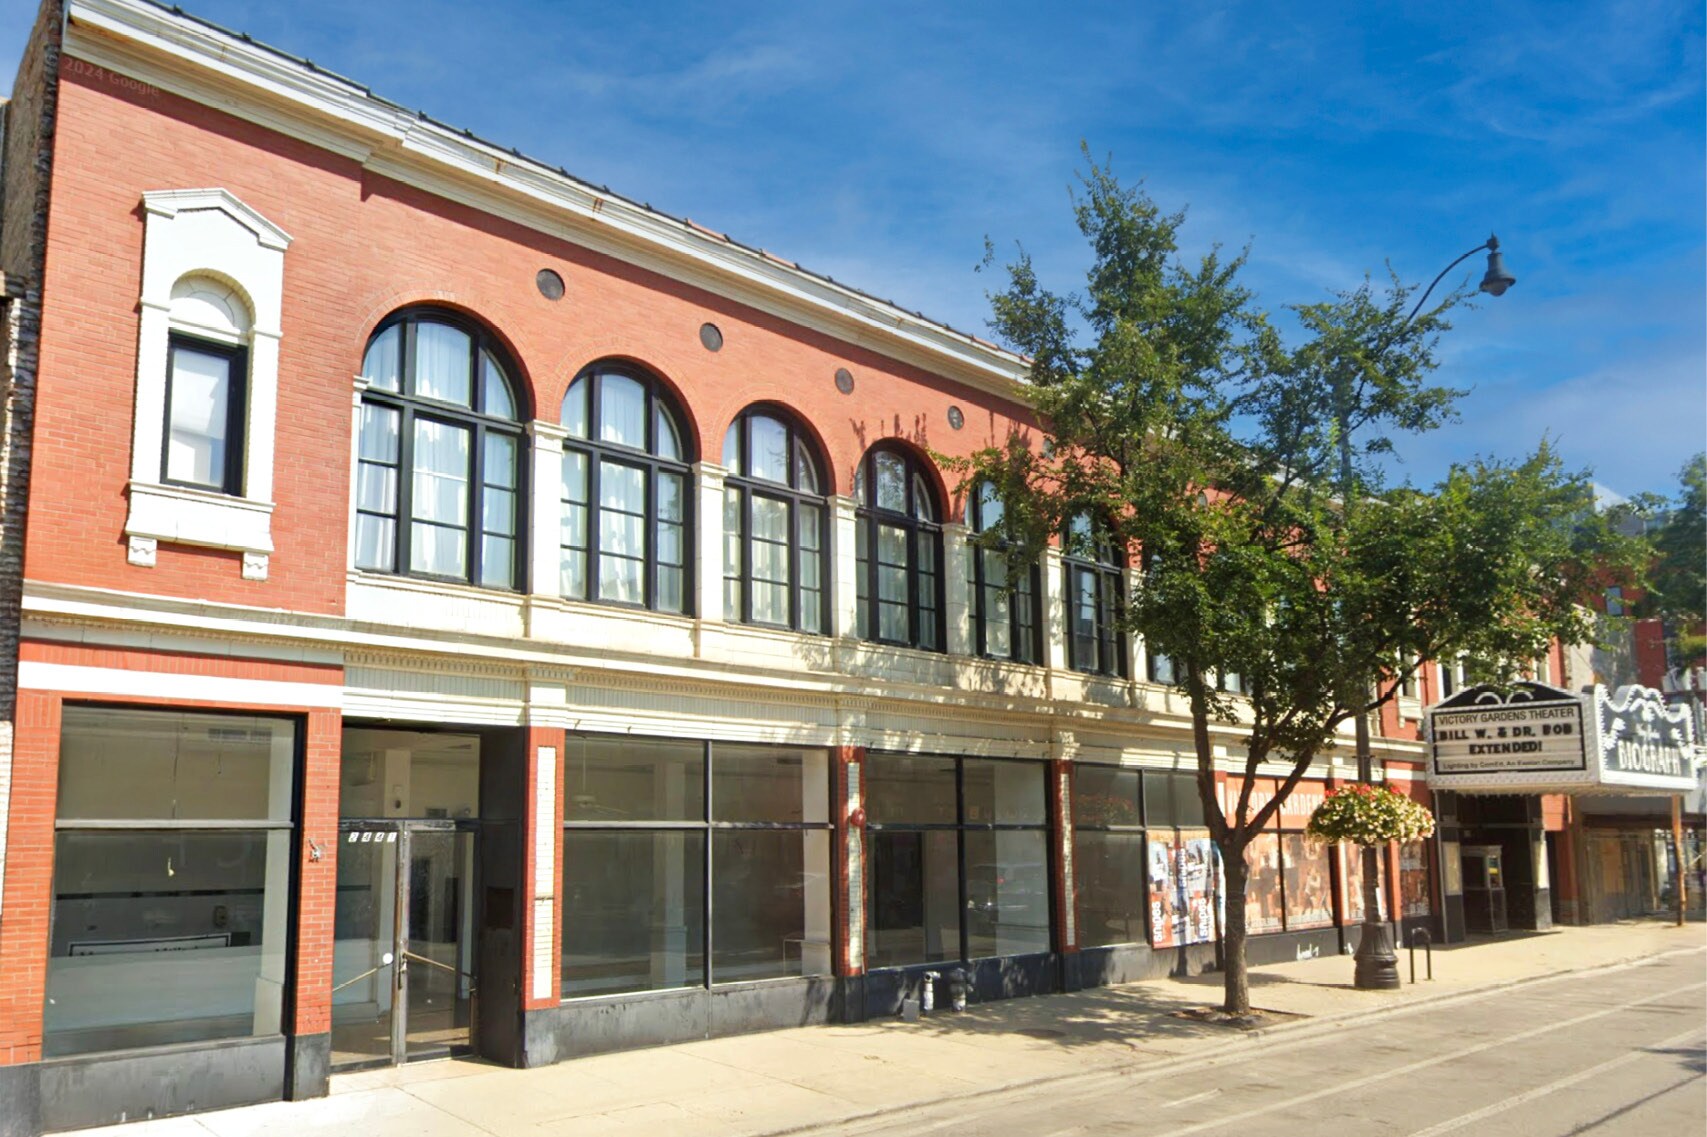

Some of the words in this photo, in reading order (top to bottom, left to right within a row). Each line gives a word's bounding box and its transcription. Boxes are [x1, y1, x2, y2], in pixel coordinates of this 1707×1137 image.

[1439, 713, 1478, 725] VICTORY
[1481, 710, 1526, 722] GARDENS
[1528, 708, 1574, 719] THEATER
[1439, 730, 1469, 741] BILL
[1475, 728, 1492, 739] W.
[1512, 726, 1536, 737] DR.
[1542, 723, 1573, 735] BOB
[1469, 741, 1542, 754] EXTENDED!
[1618, 740, 1681, 776] BIOGRAPH
[1227, 790, 1272, 815] VIORY
